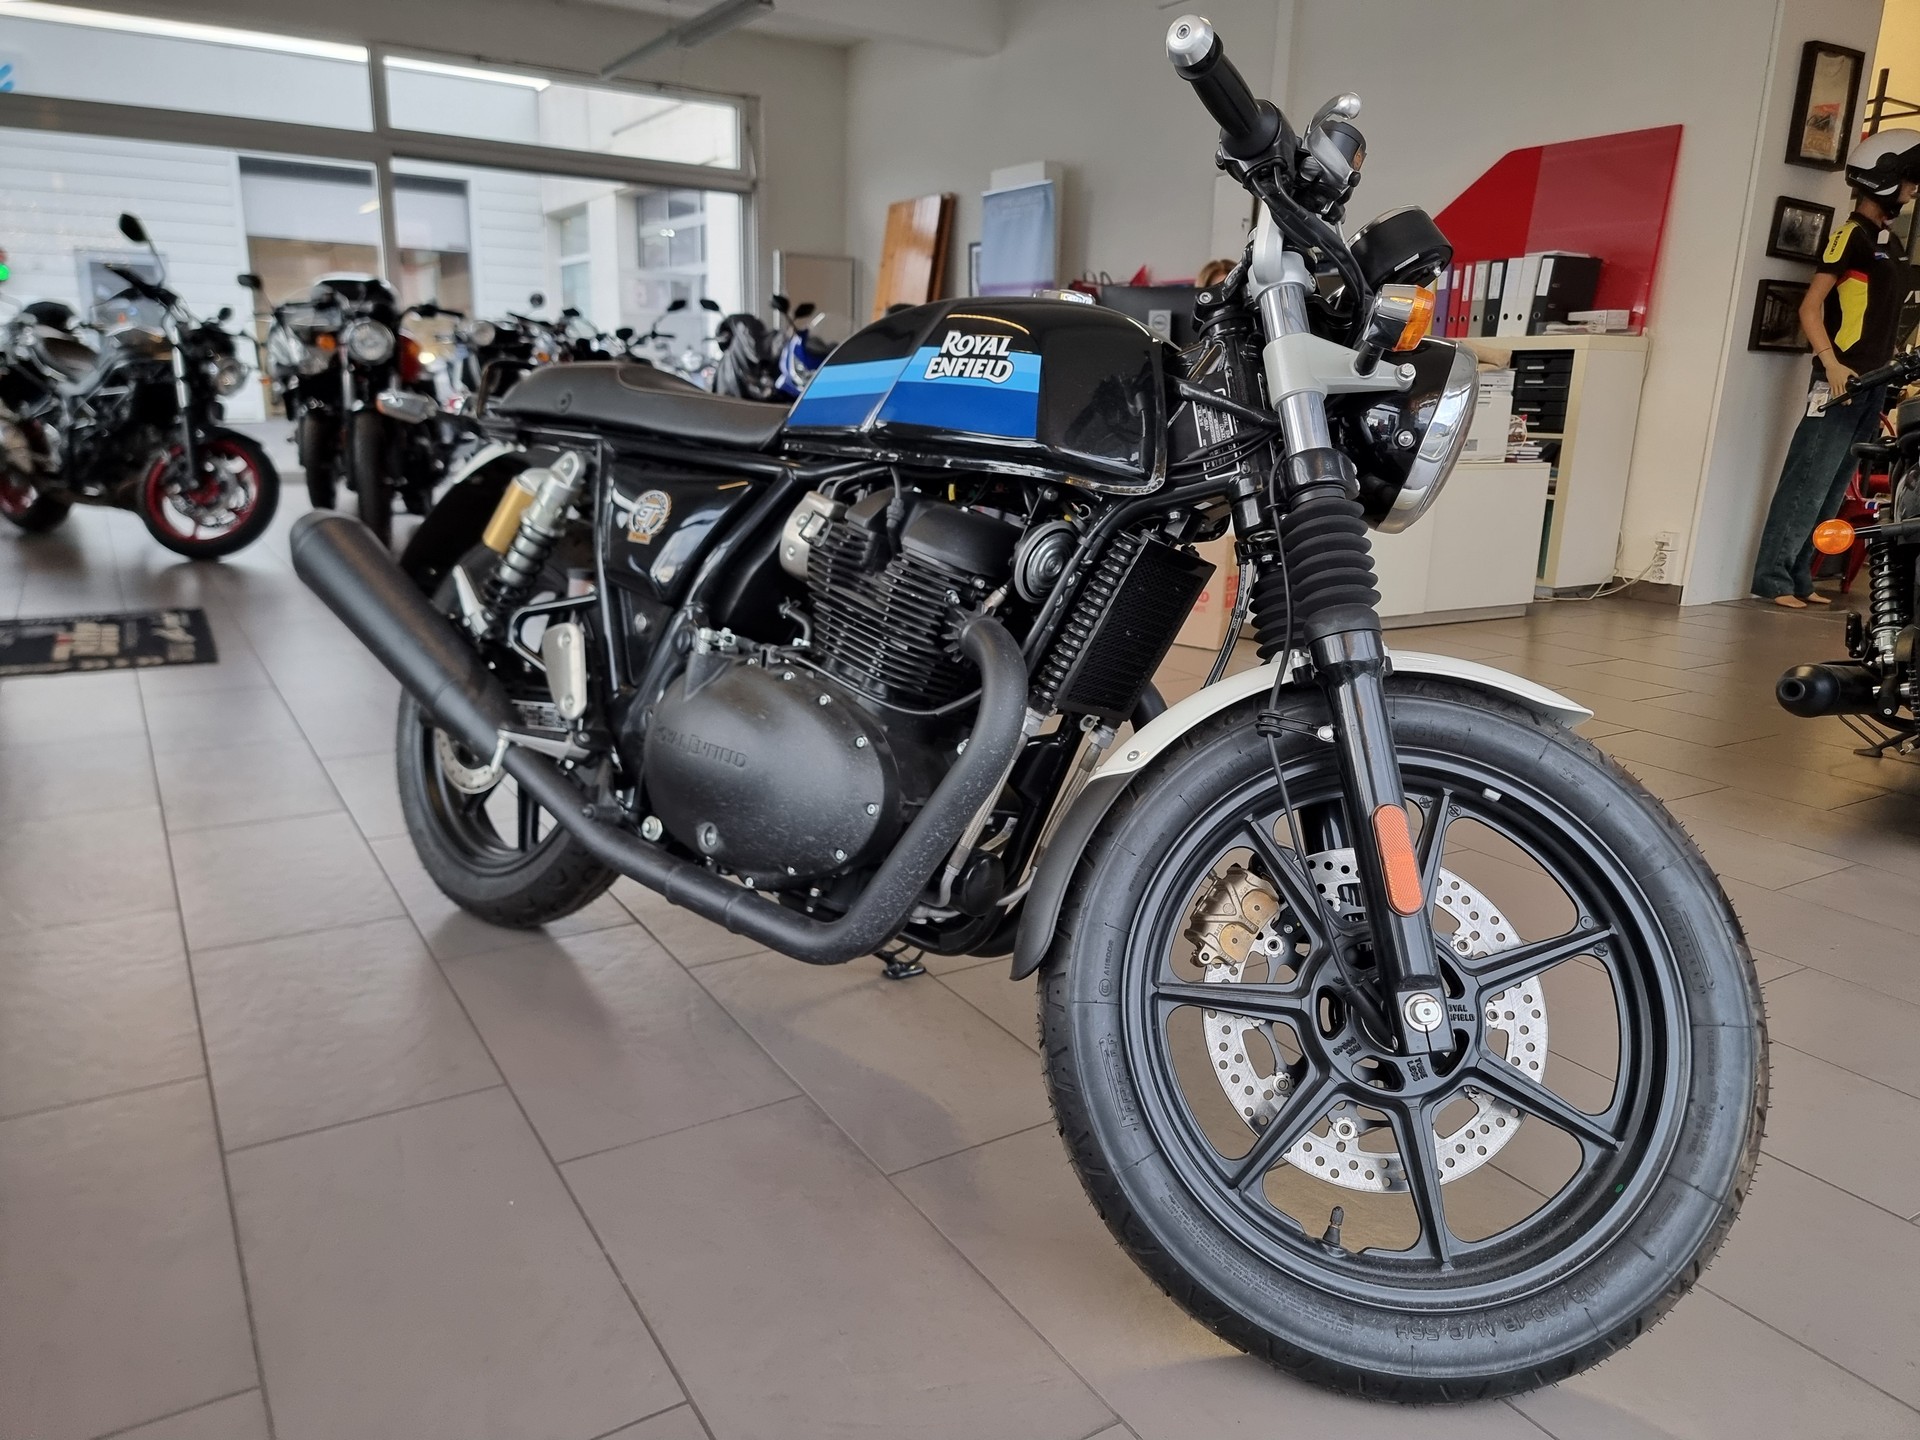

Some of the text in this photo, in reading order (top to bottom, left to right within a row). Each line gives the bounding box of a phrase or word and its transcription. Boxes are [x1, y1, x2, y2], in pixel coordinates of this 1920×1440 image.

[940, 329, 1012, 356] ROYAL
[924, 357, 1014, 383] ENFIELD
[1449, 1012, 1475, 1021] FIELD
